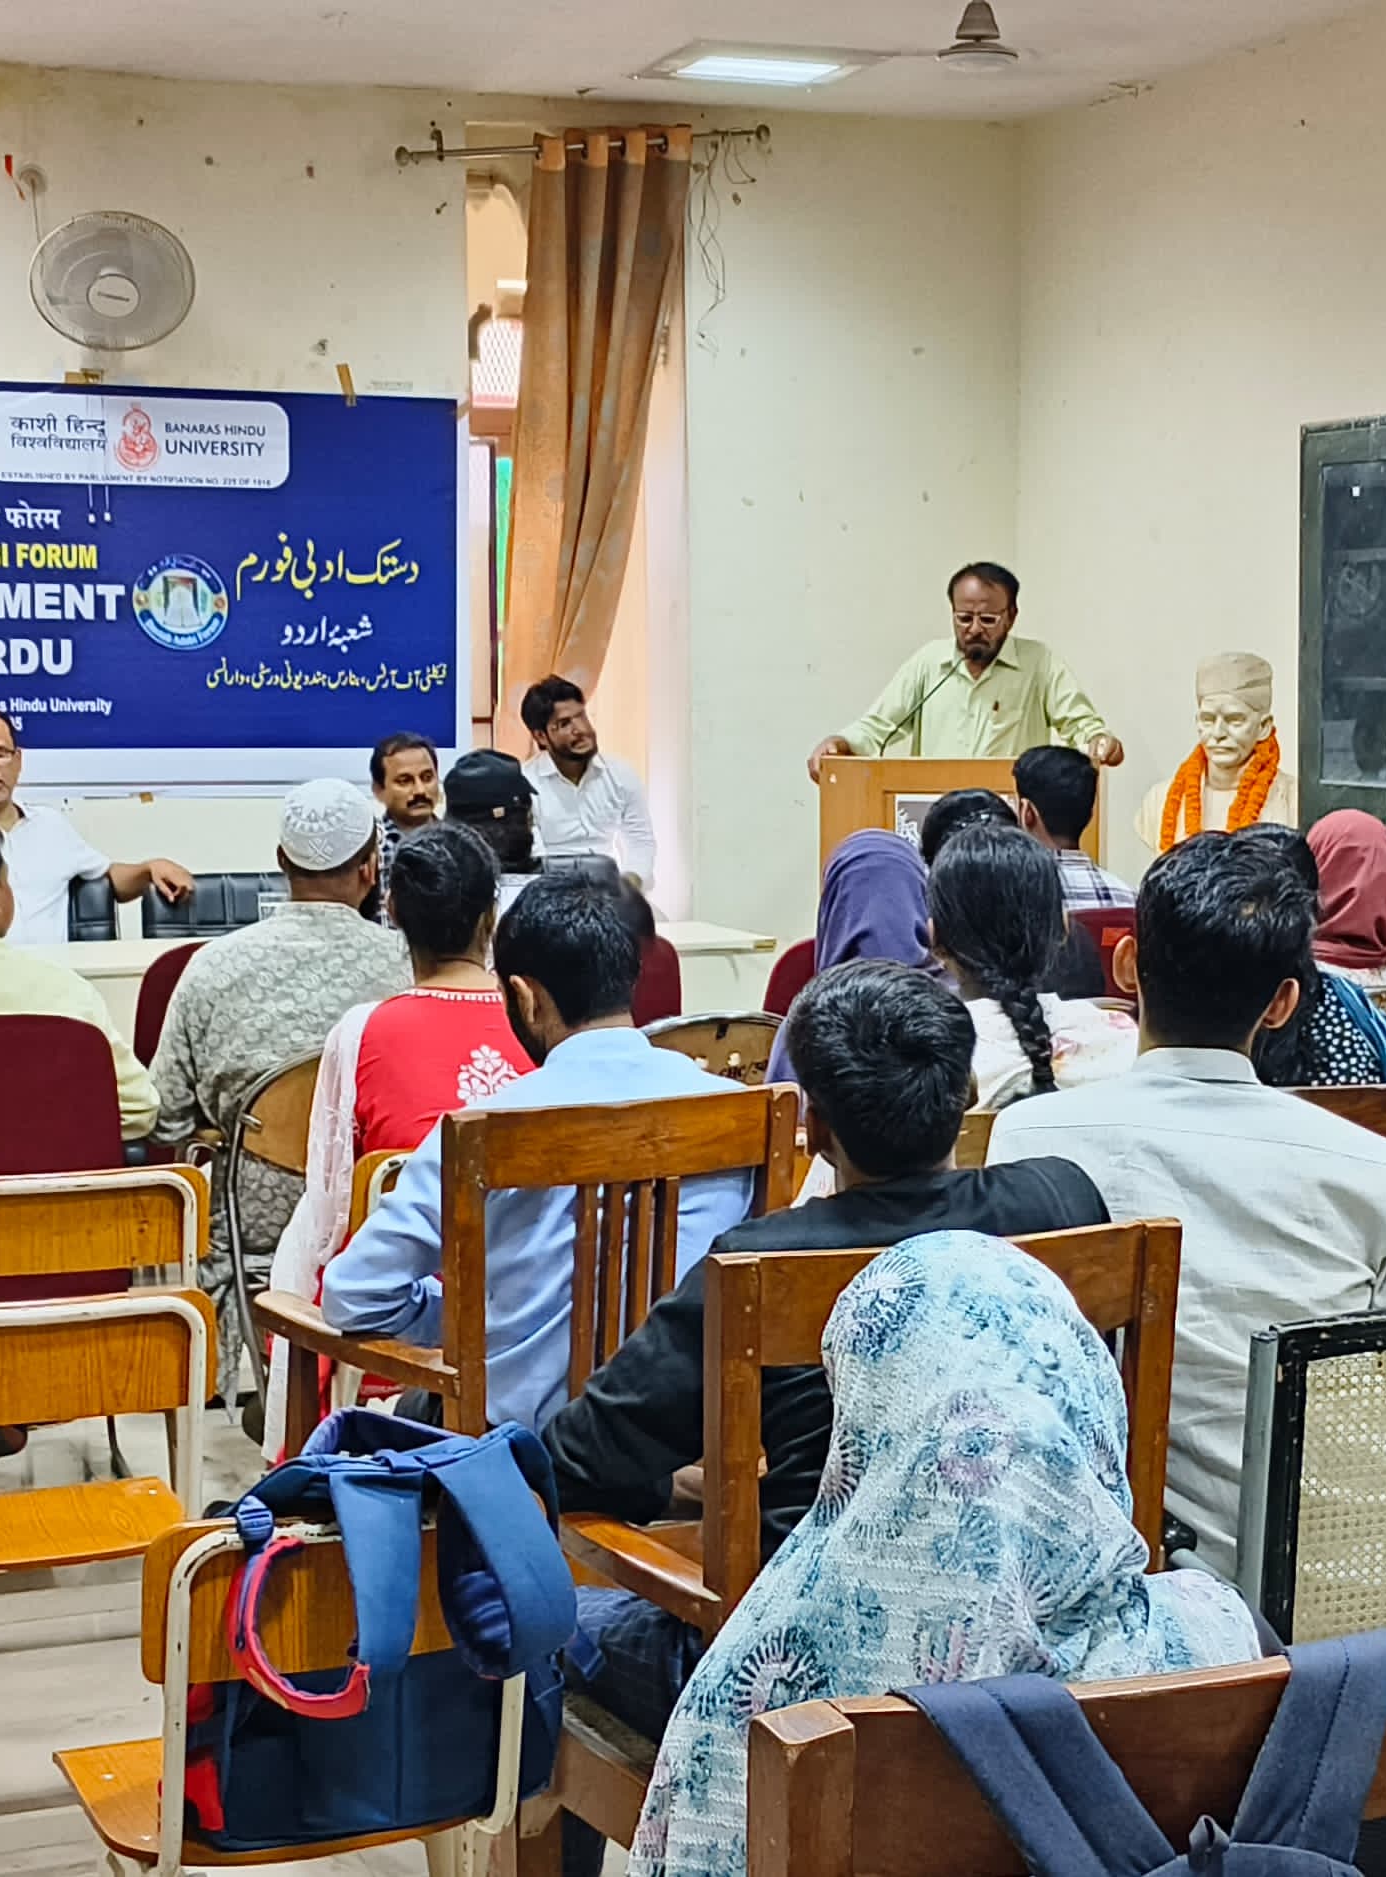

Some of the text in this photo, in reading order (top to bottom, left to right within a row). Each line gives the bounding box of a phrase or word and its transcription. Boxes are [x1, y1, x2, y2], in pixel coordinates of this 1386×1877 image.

[9, 413, 57, 433] काशी
[165, 422, 266, 437] BANARAS HINDU
[11, 432, 106, 453] विश्वविद्यालय
[165, 439, 265, 457] UNIVERSITY
[1, 471, 62, 481] ESTABLISHED
[64, 473, 76, 481] BY
[136, 475, 148, 483] BY
[5, 499, 62, 530] फोरम
[16, 543, 98, 570] FORUM
[235, 531, 294, 601] فورم
[290, 538, 345, 599] ادبی
[345, 538, 420, 585] دستک
[280, 615, 328, 646] اردو
[9, 697, 47, 713] Hindu
[50, 698, 113, 716] University
